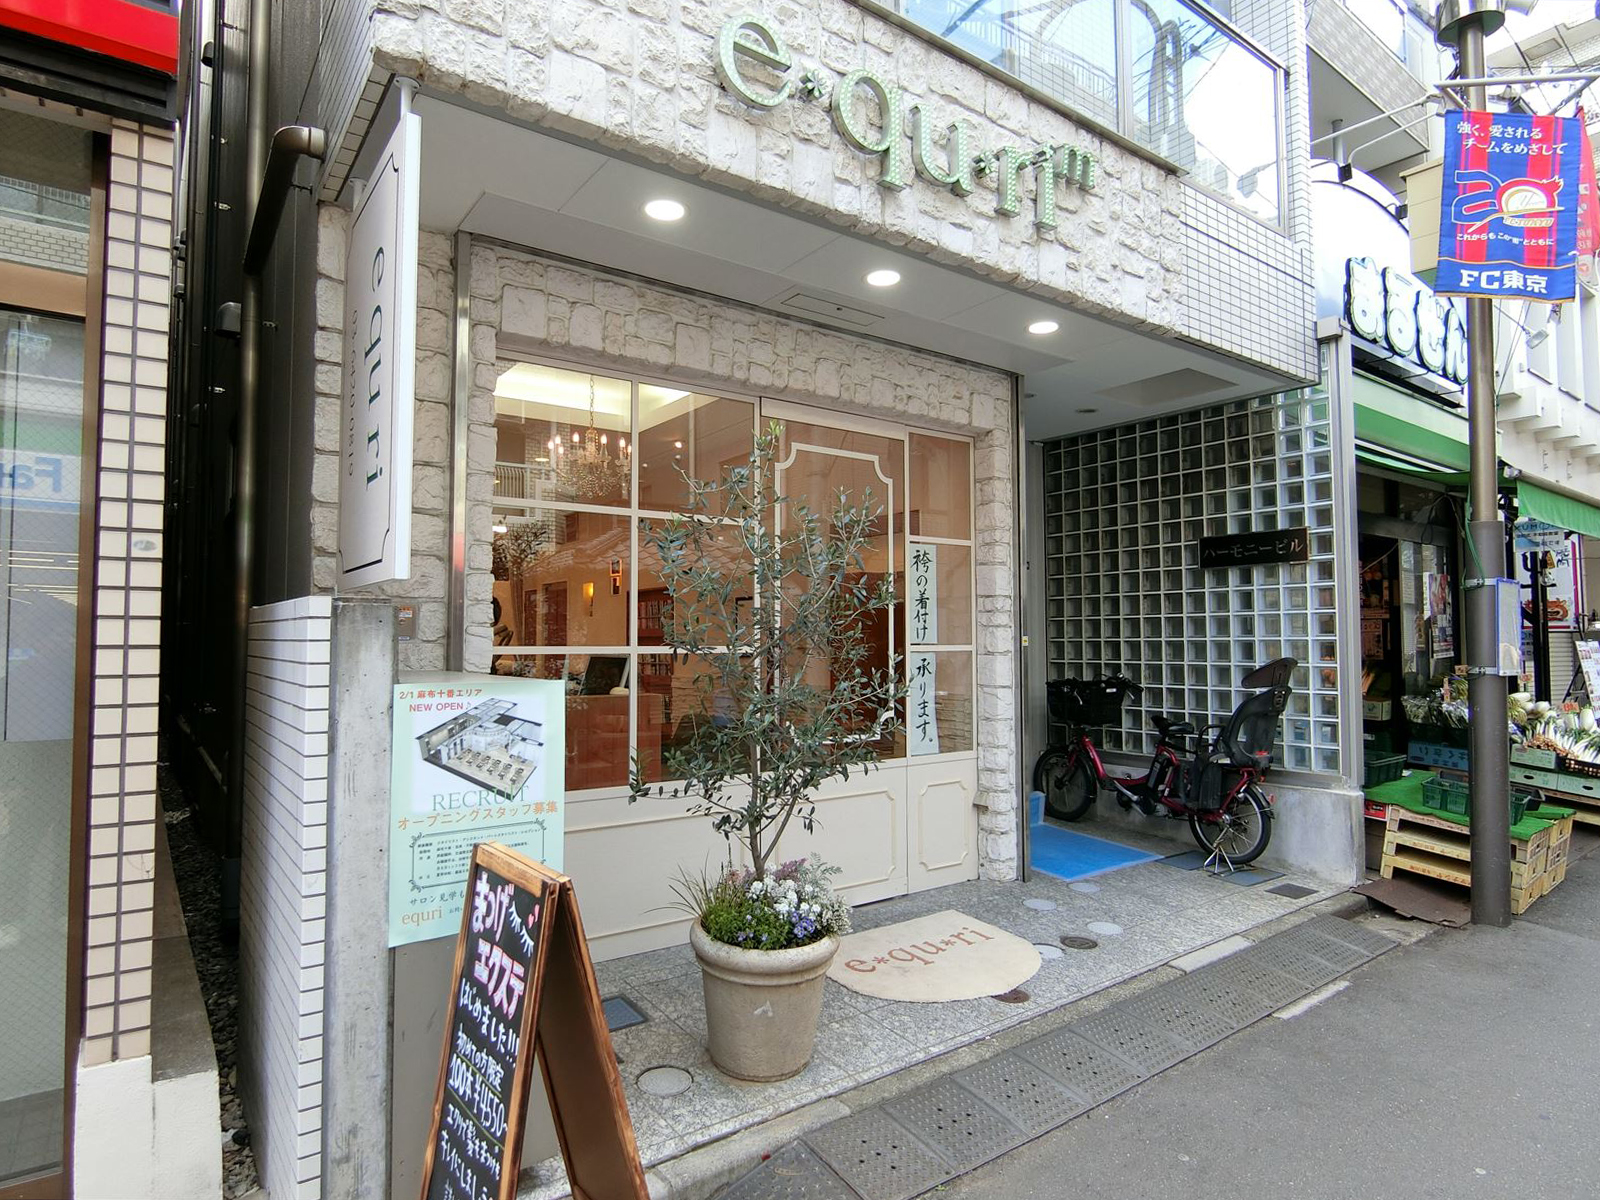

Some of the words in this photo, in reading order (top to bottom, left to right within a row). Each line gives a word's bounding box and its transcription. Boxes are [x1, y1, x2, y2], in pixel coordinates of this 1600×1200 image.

[1463, 137, 1568, 156] チームをめざして
[1459, 269, 1548, 294] FC東京
[363, 245, 386, 491] equri
[1203, 538, 1304, 558] ハーモニービル
[910, 548, 933, 643] 袴の着付け
[399, 690, 414, 700] 2/1
[416, 688, 483, 699] 麻布十番エリア
[409, 702, 432, 713] NEW
[915, 656, 933, 744] 承ります。
[432, 785, 529, 812] RECRUIT
[397, 800, 558, 831] オープニングスタッフ募集
[402, 905, 443, 927] equri
[471, 870, 515, 943] まつげ
[473, 937, 526, 1018] エクステ
[456, 1022, 504, 1092] 初めての方限定
